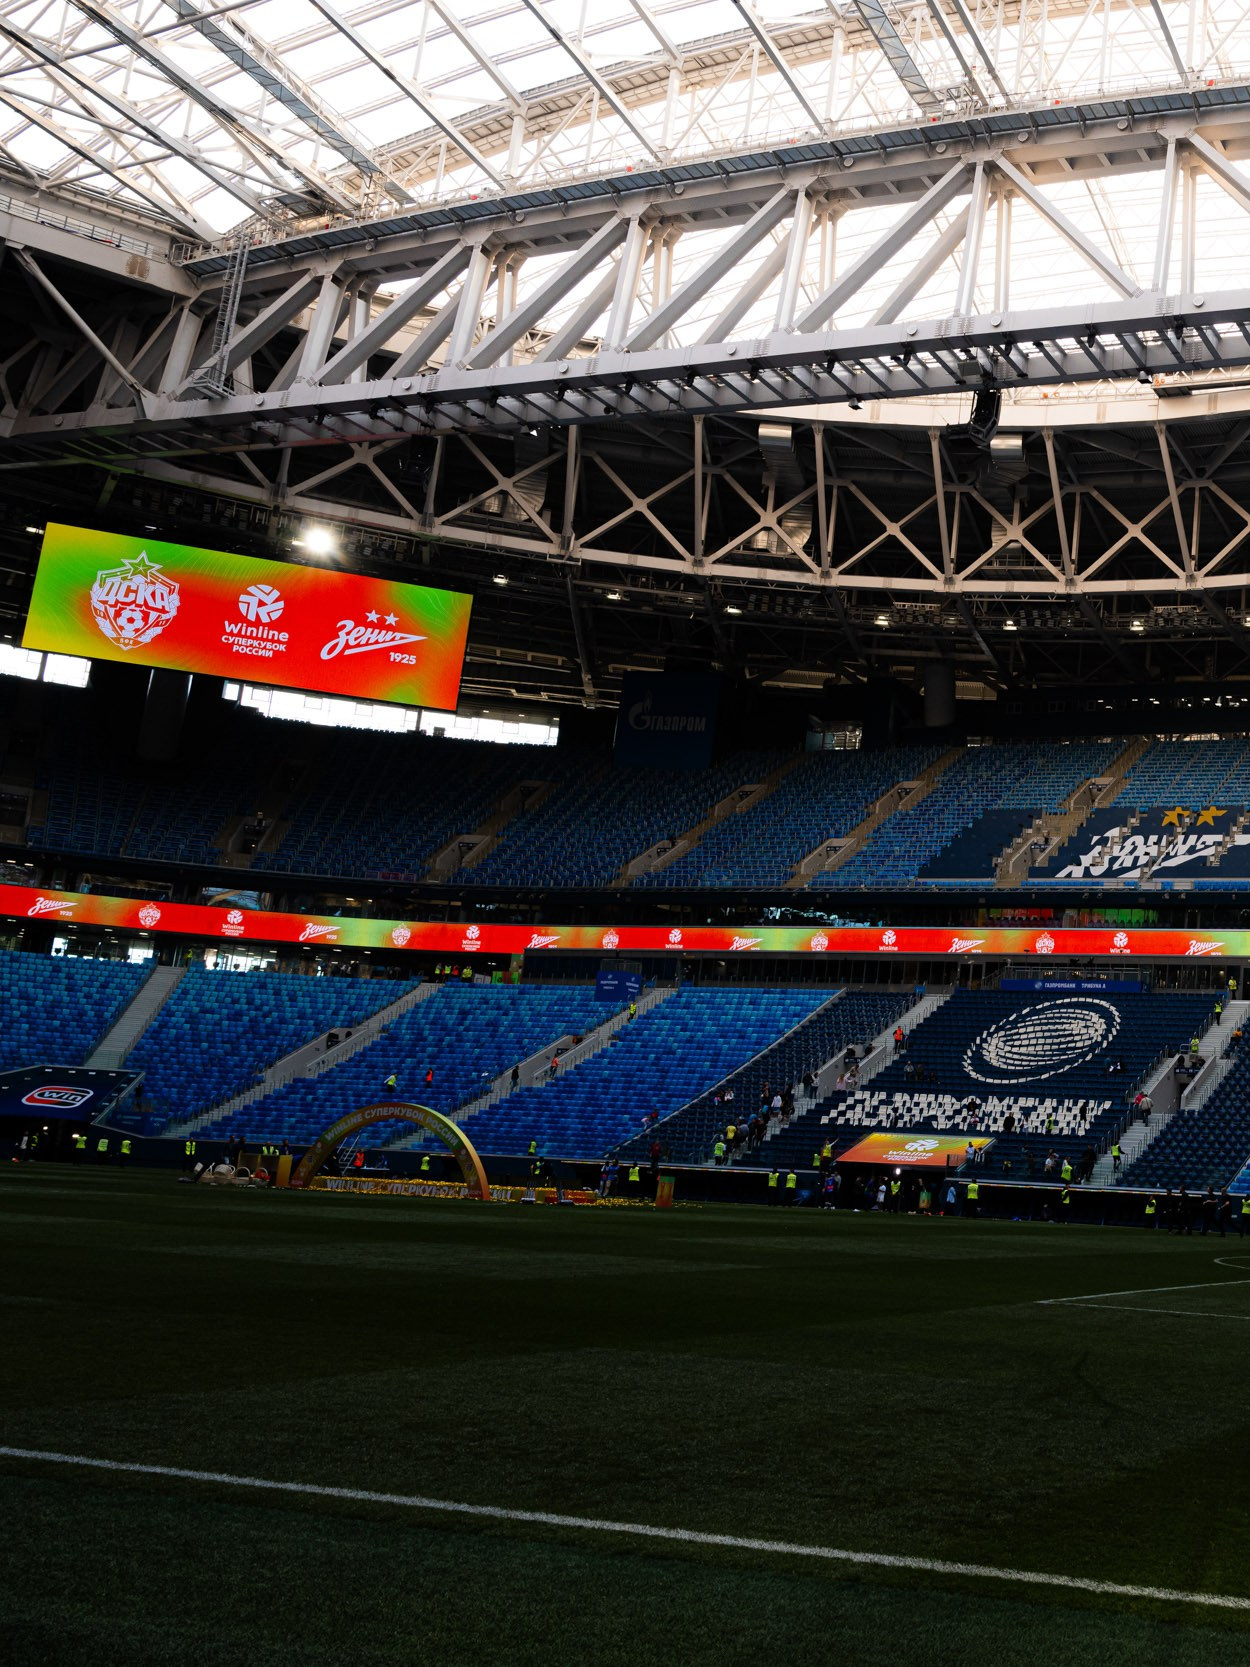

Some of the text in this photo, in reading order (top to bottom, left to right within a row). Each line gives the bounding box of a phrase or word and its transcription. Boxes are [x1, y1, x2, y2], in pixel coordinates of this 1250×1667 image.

[97, 576, 170, 613] ЦСКА
[224, 620, 289, 642] Winline
[221, 635, 287, 652] СУПЕРКУБОК
[232, 644, 273, 658] РОССИИ
[389, 651, 417, 665] 1925
[650, 714, 706, 733] ГАЗПРОМ
[222, 923, 244, 931] Winline
[43, 1090, 82, 1103] Win
[324, 1106, 459, 1146] WINLINE СУПЕРКУБОК РОССИИ
